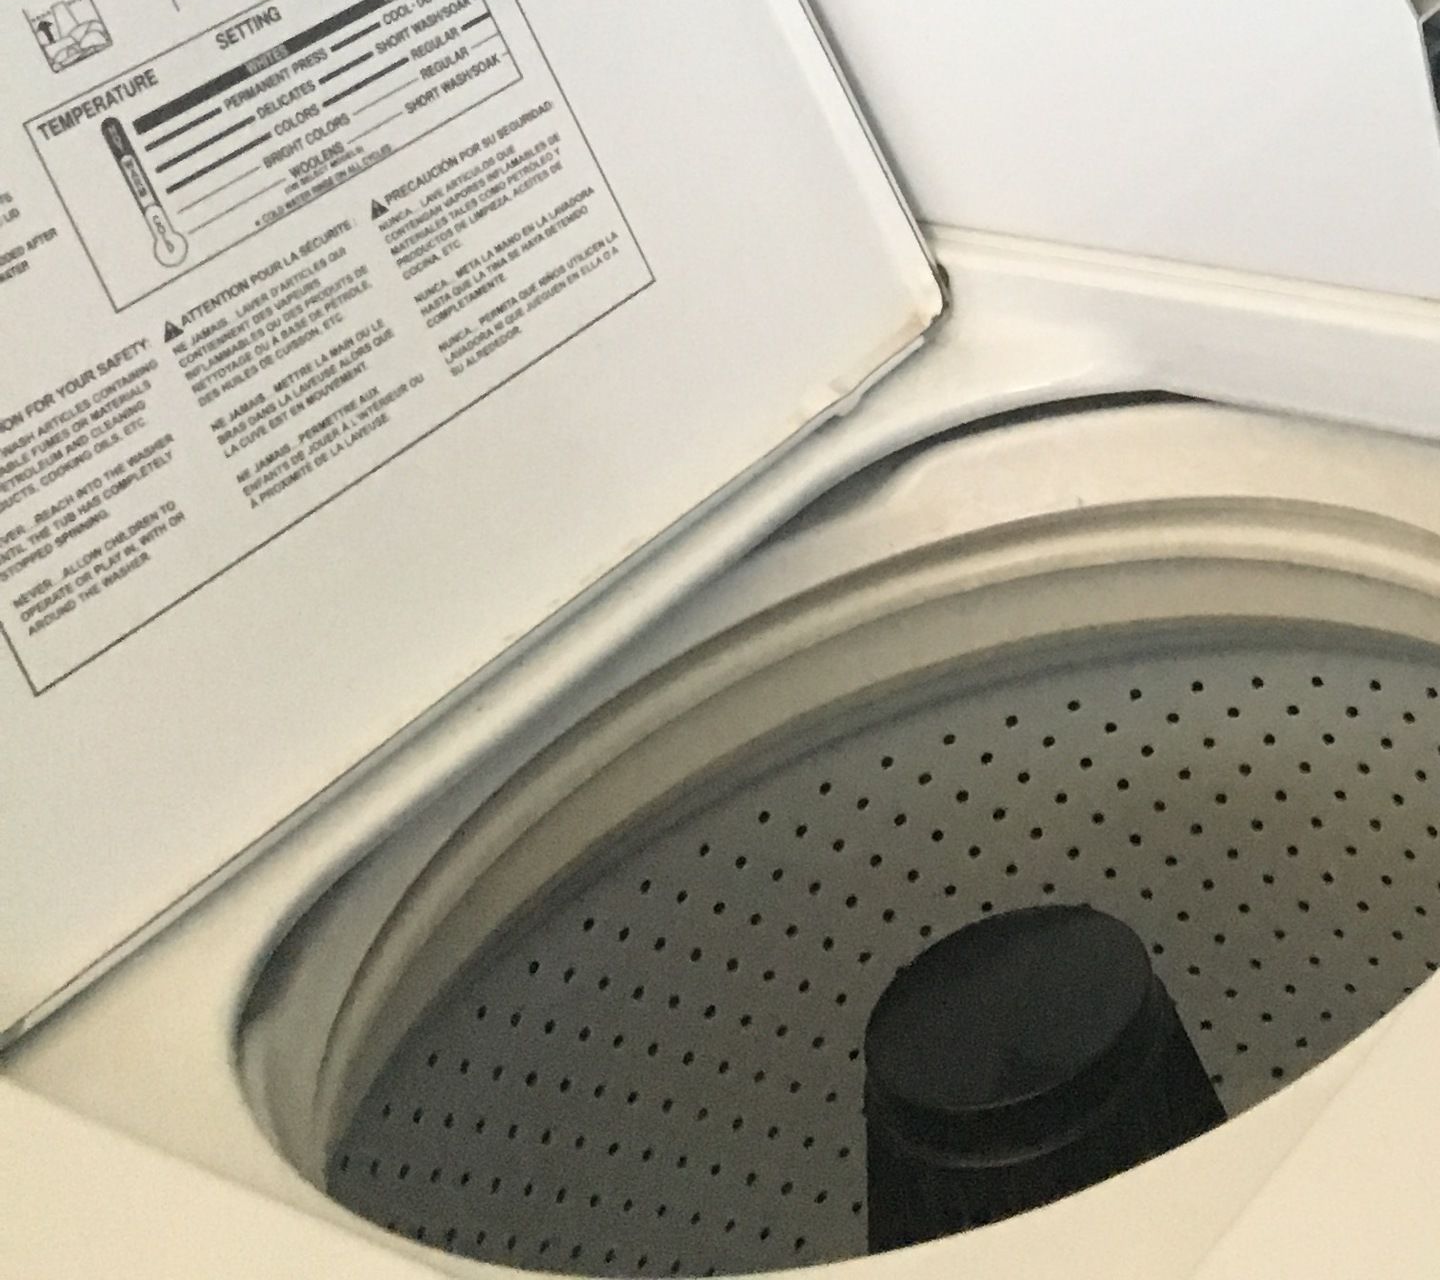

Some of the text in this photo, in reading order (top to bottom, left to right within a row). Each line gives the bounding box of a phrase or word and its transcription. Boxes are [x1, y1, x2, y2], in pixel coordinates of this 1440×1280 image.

[35, 66, 160, 143] TEMPERATURE
[212, 3, 283, 51] SETTING
[222, 65, 292, 112] PERMANENT
[290, 46, 329, 76] PRESS
[244, 42, 290, 75] WHITES
[254, 78, 317, 120] DELICATES
[373, 26, 413, 56] SHORT
[271, 25, 460, 137] COLORS REGULAR
[261, 136, 306, 170] BRIGHT
[303, 111, 352, 146] COLORS
[418, 45, 470, 82] REGULAR
[287, 139, 345, 181] WOOLENS
[403, 85, 442, 115] SHORT
[458, 141, 483, 162] POR
[480, 132, 497, 149] SU
[24, 226, 59, 252] AFTER
[178, 248, 300, 327] ATTENTION POUR LA
[23, 368, 97, 419] FOR YOUR
[29, 378, 151, 458] FUMES OR MATERIALS
[35, 357, 159, 437] ARTICLES CONTAINING
[63, 398, 147, 455] AND CLEANING
[26, 448, 174, 548] THE TUB HAS COMPLETELY
[38, 448, 94, 488] COOKING
[74, 432, 174, 500] INTO THE WASHER
[102, 498, 176, 552] CHILDREN TO
[0, 541, 54, 583] STOPPED
[19, 510, 185, 624] OPERATE OR PLAY WITH OR
[26, 582, 101, 637] AROUND THE
